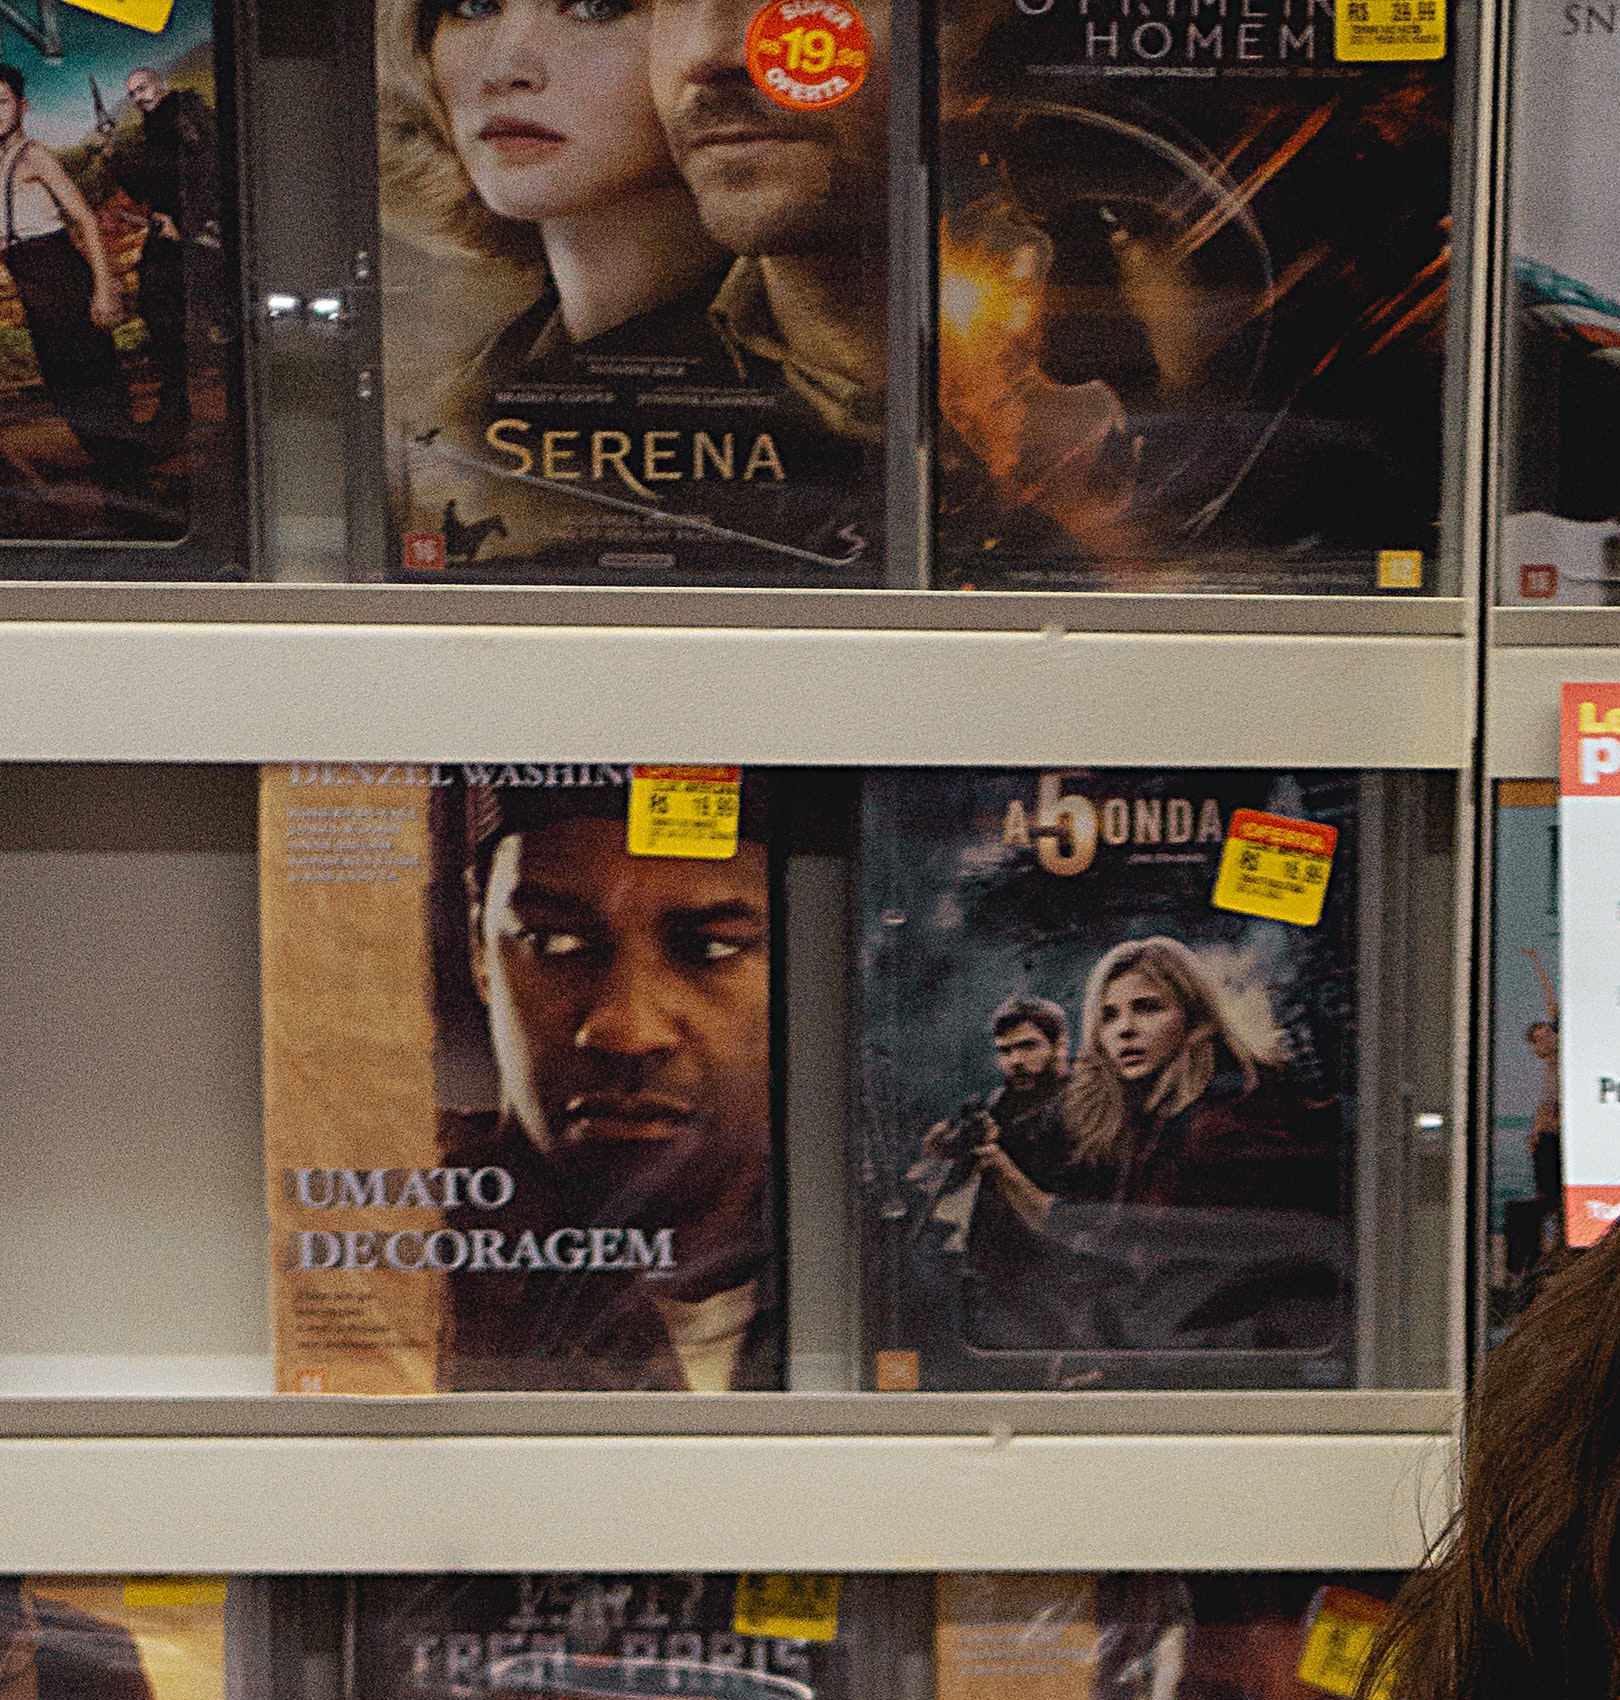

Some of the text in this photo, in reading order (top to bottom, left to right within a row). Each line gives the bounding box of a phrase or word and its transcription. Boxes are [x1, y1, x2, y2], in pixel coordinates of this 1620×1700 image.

[1086, 22, 1316, 60] HOMEM
[766, 67, 850, 102] OFERTA
[485, 419, 786, 499] SERENA
[1002, 800, 1030, 846] A
[1102, 798, 1223, 846] ONDA
[1238, 819, 1326, 852] OFERTA
[384, 1228, 677, 1272] CORAGEM
